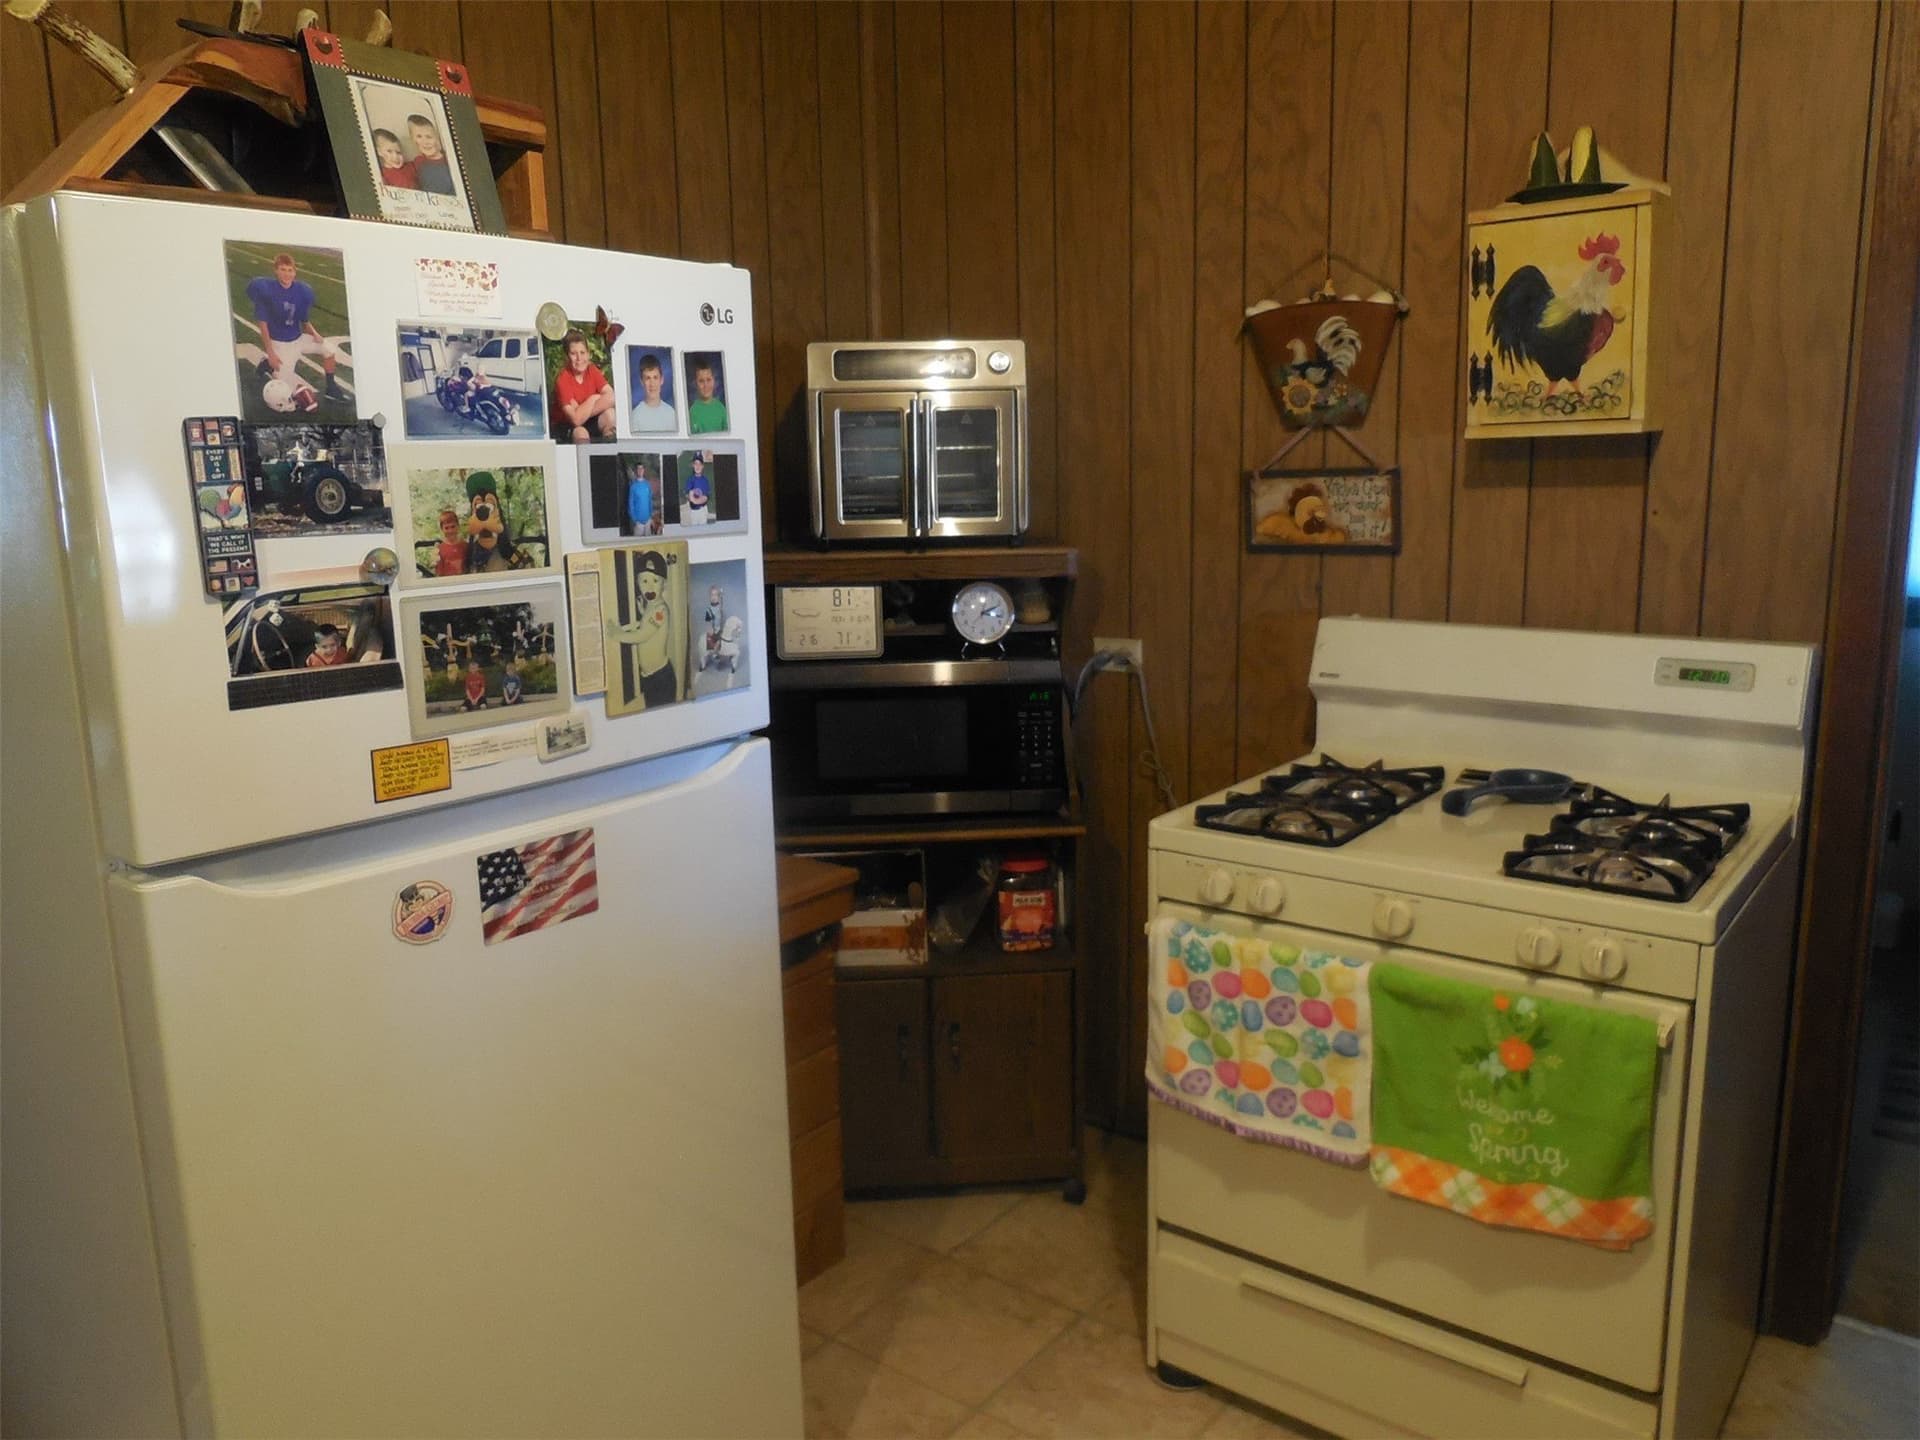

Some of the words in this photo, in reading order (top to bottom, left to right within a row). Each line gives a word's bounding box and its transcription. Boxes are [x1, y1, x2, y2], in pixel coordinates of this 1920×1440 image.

[283, 301, 296, 326] 7
[716, 307, 734, 325] LG
[1456, 1083, 1555, 1126] Welcome
[1468, 1121, 1570, 1178] Spring
